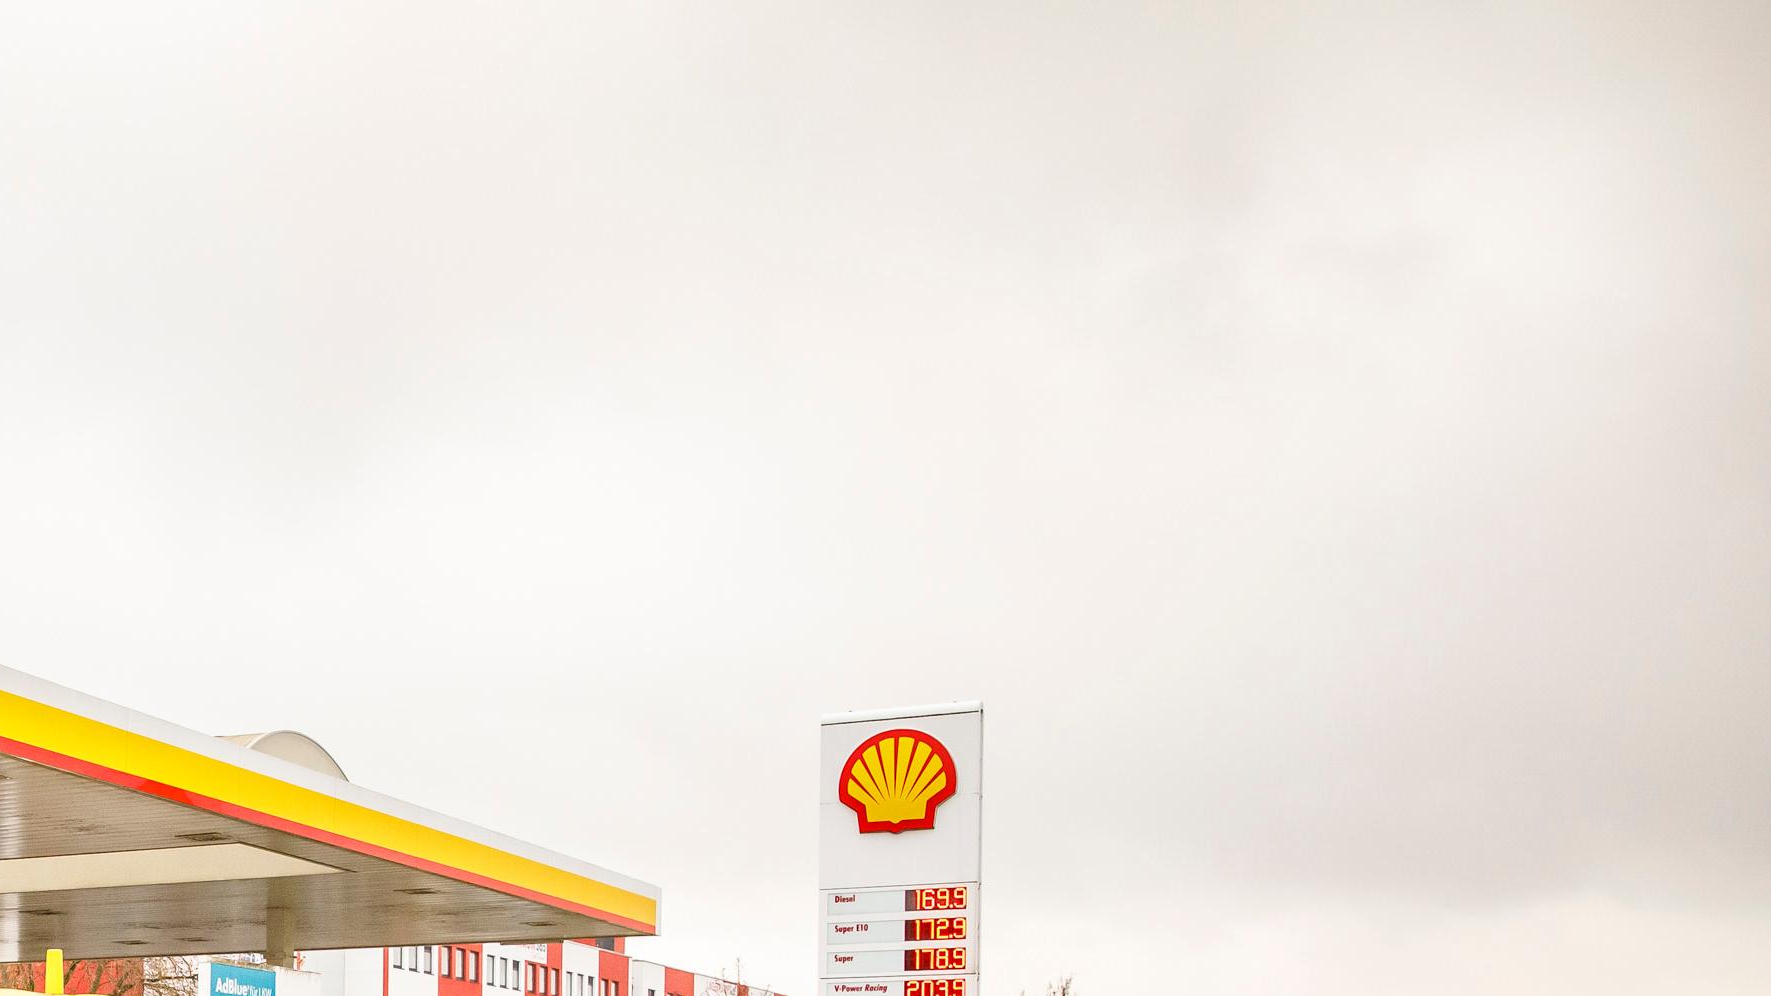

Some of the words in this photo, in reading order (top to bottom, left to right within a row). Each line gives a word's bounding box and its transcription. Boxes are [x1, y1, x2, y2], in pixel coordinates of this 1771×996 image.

[834, 895, 856, 904] Diesel
[915, 887, 966, 910] 169.9
[834, 926, 854, 934] Super
[856, 924, 869, 932] E10
[915, 918, 966, 940] 172.9
[834, 955, 854, 963] Super
[915, 948, 966, 970] 178.9
[249, 986, 258, 996] für
[834, 984, 863, 992] V-Power
[864, 984, 888, 993] Racing
